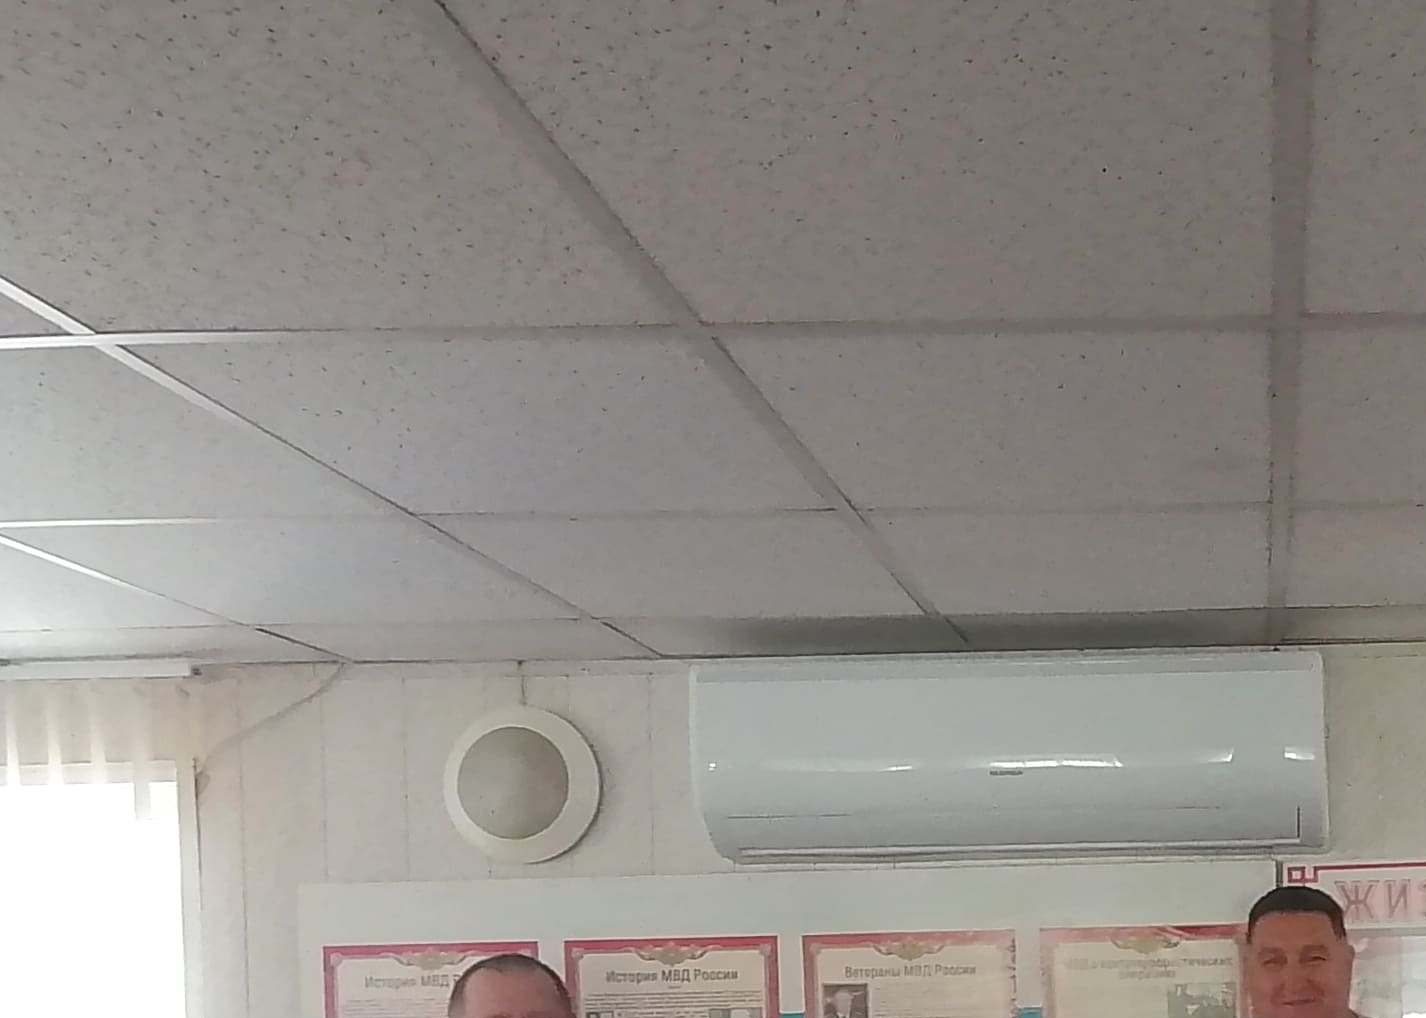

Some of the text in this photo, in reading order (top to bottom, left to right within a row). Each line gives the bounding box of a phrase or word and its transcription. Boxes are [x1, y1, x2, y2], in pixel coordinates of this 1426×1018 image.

[605, 968, 739, 984] История МВД России
[844, 963, 977, 979] Ветераны МВД России
[420, 974, 450, 988] МВД
